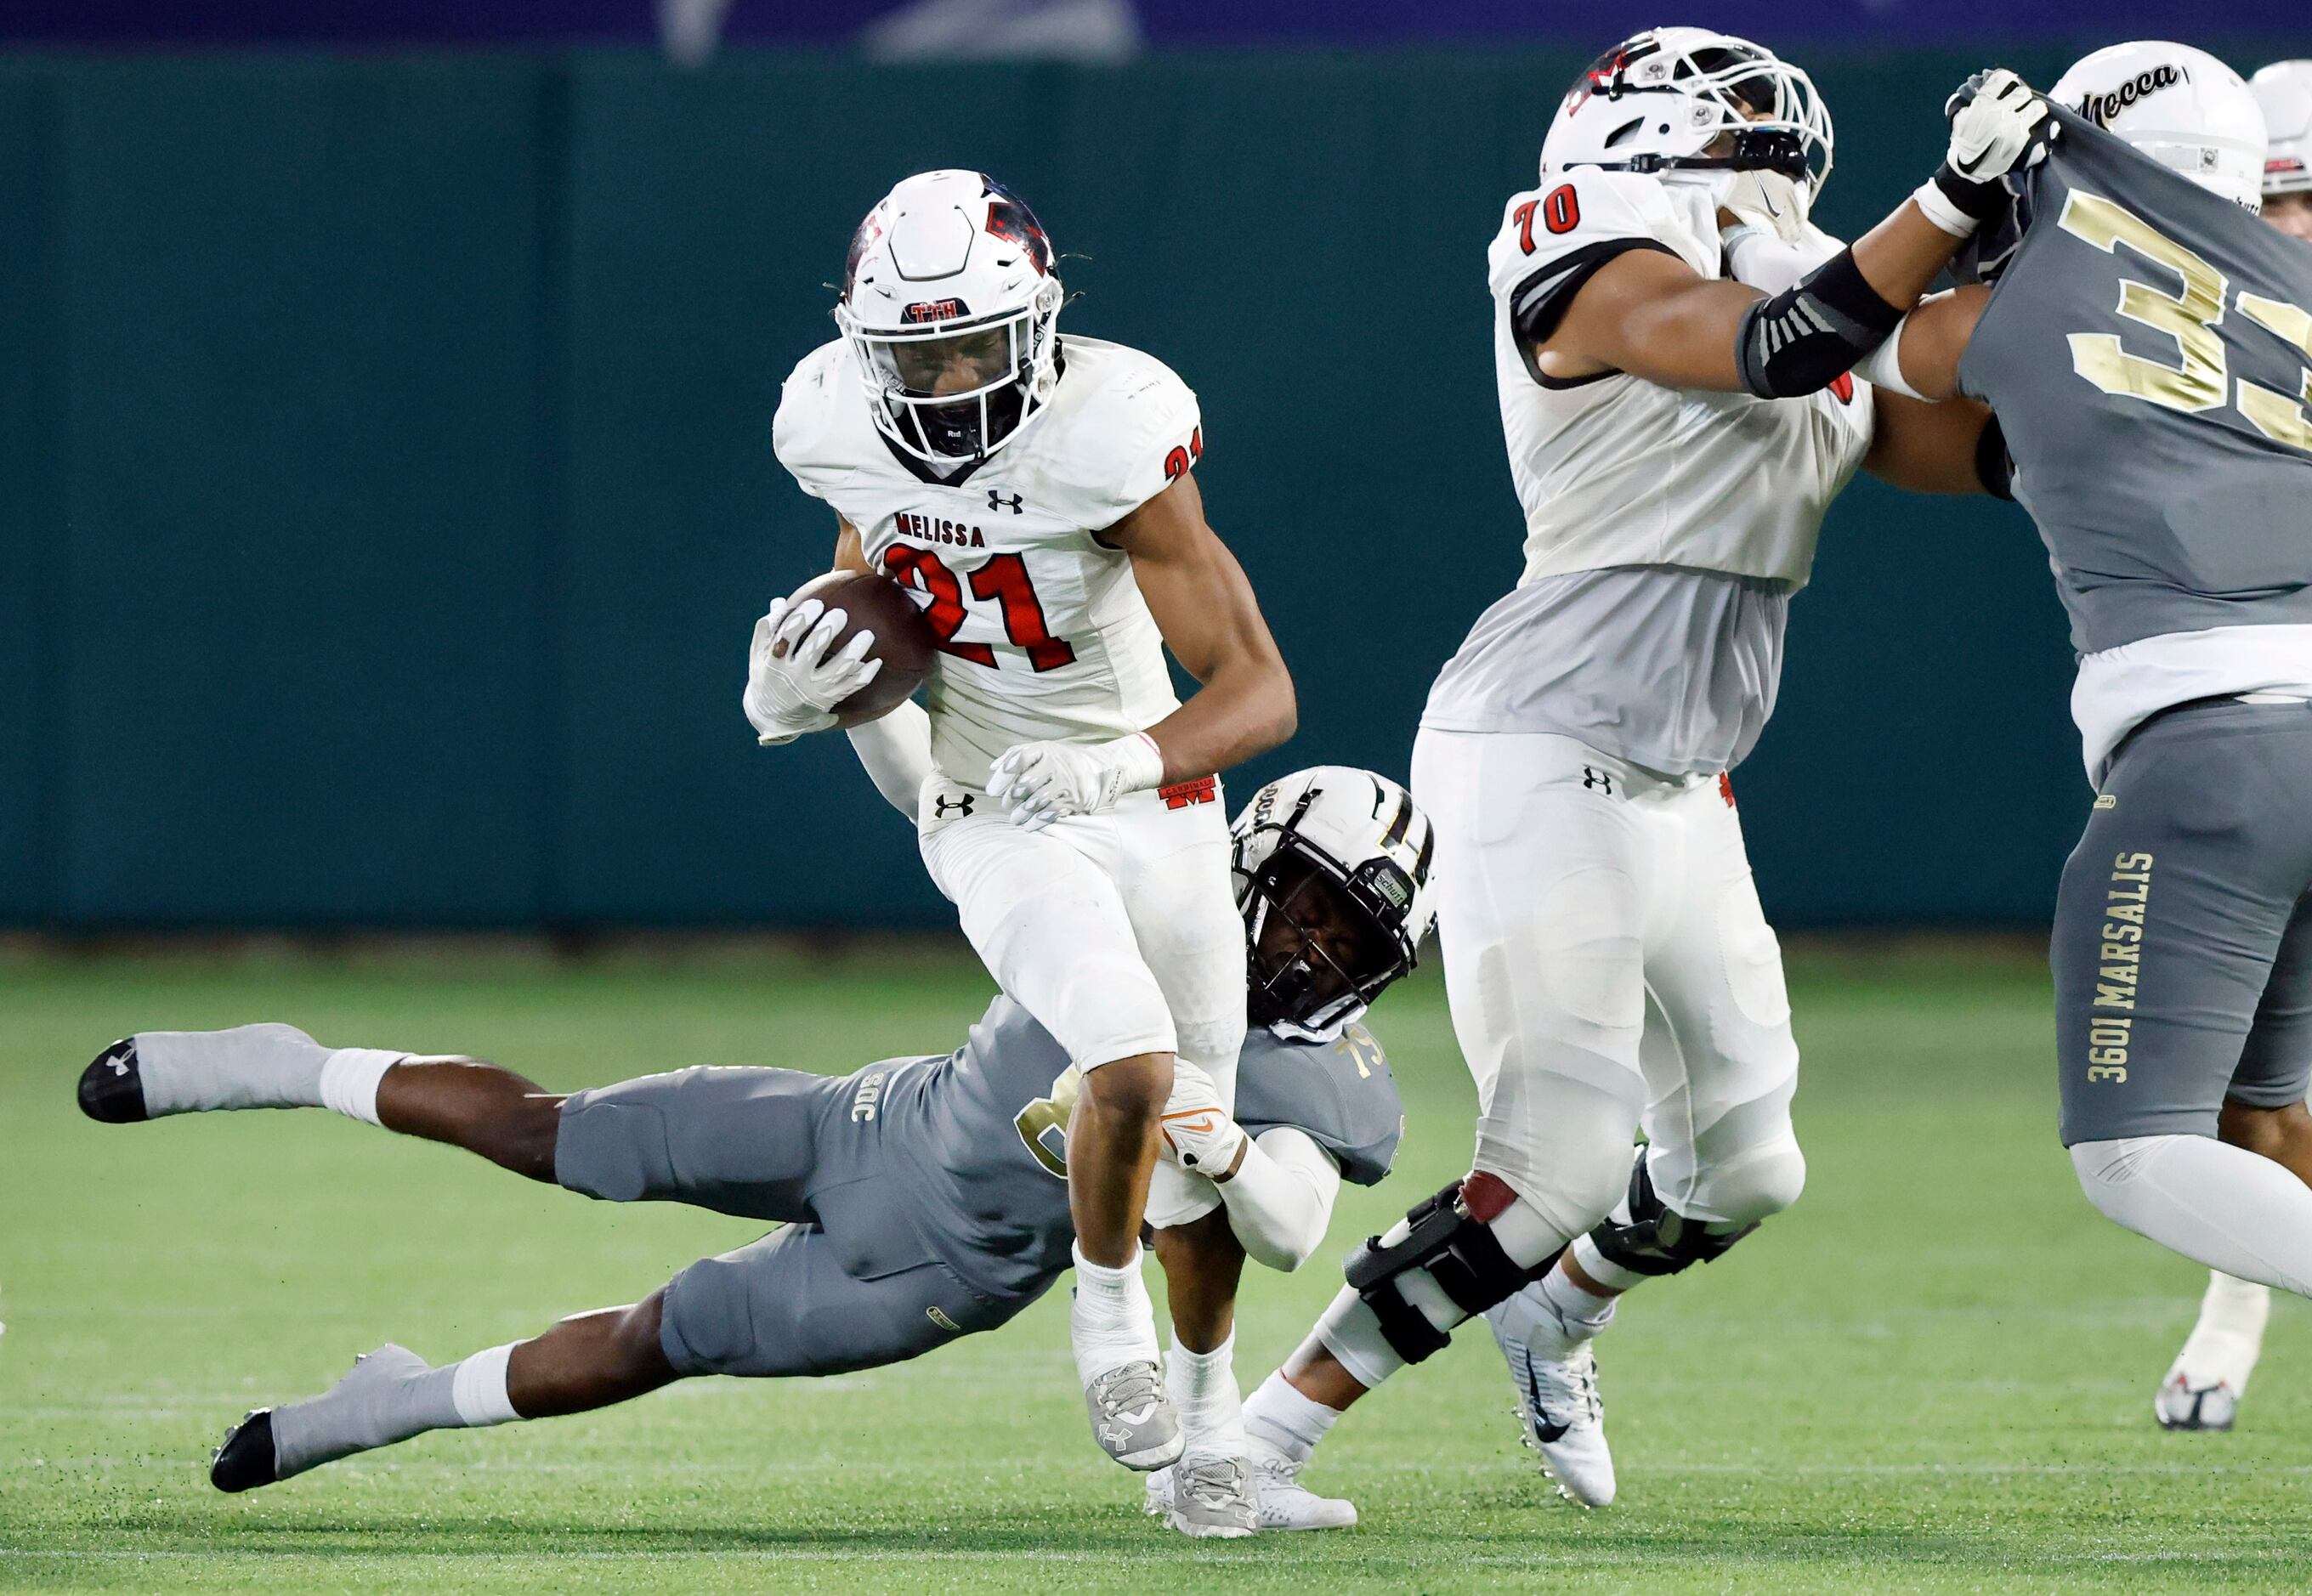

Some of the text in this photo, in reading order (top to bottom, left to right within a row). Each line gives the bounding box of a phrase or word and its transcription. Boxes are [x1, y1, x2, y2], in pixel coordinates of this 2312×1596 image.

[2074, 65, 2178, 133] Mecca
[1513, 184, 1580, 256] 70
[910, 300, 958, 322] TTH
[894, 512, 985, 549] MELISSA
[884, 542, 1078, 673] 21
[2093, 852, 2153, 1010] MARSALIS
[850, 1072, 884, 1123] SOC
